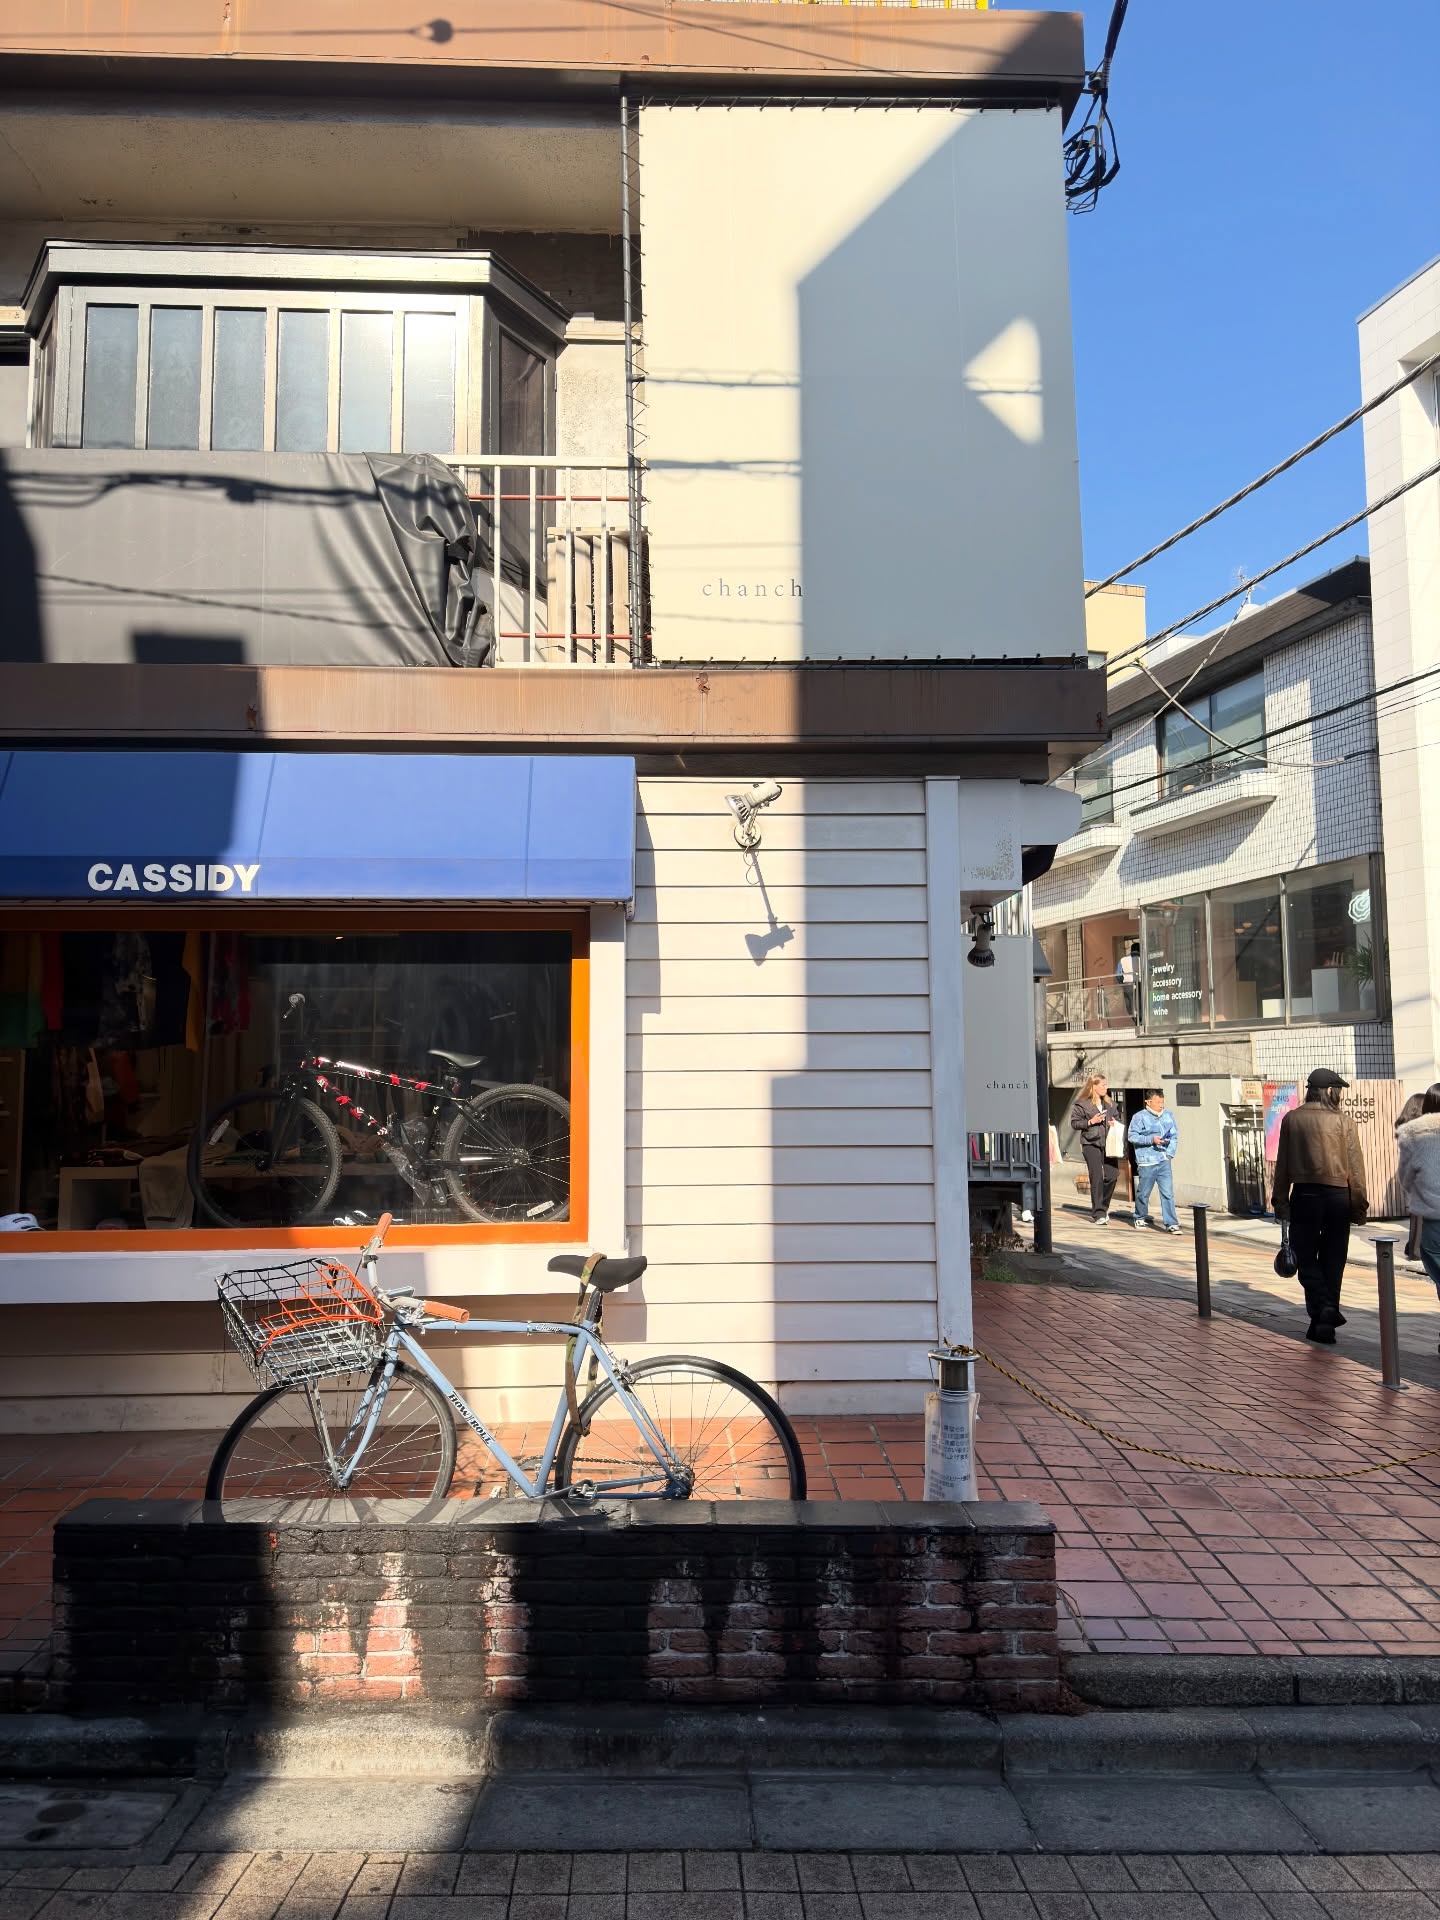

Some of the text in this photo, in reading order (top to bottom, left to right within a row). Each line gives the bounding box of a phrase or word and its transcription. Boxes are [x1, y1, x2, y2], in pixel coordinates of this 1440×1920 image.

[702, 577, 803, 597] chanch
[87, 863, 261, 893] CASSIDY
[1151, 962, 1175, 976] jewelry
[1152, 977, 1182, 988] accessory
[1152, 989, 1203, 1002] home accessory
[1153, 1007, 1169, 1016] wine
[986, 1080, 1029, 1089] chanch
[1340, 1094, 1375, 1107] radise
[1344, 1107, 1376, 1124] ntage
[448, 1392, 470, 1417] HOW
[470, 1419, 493, 1445] ROLL
